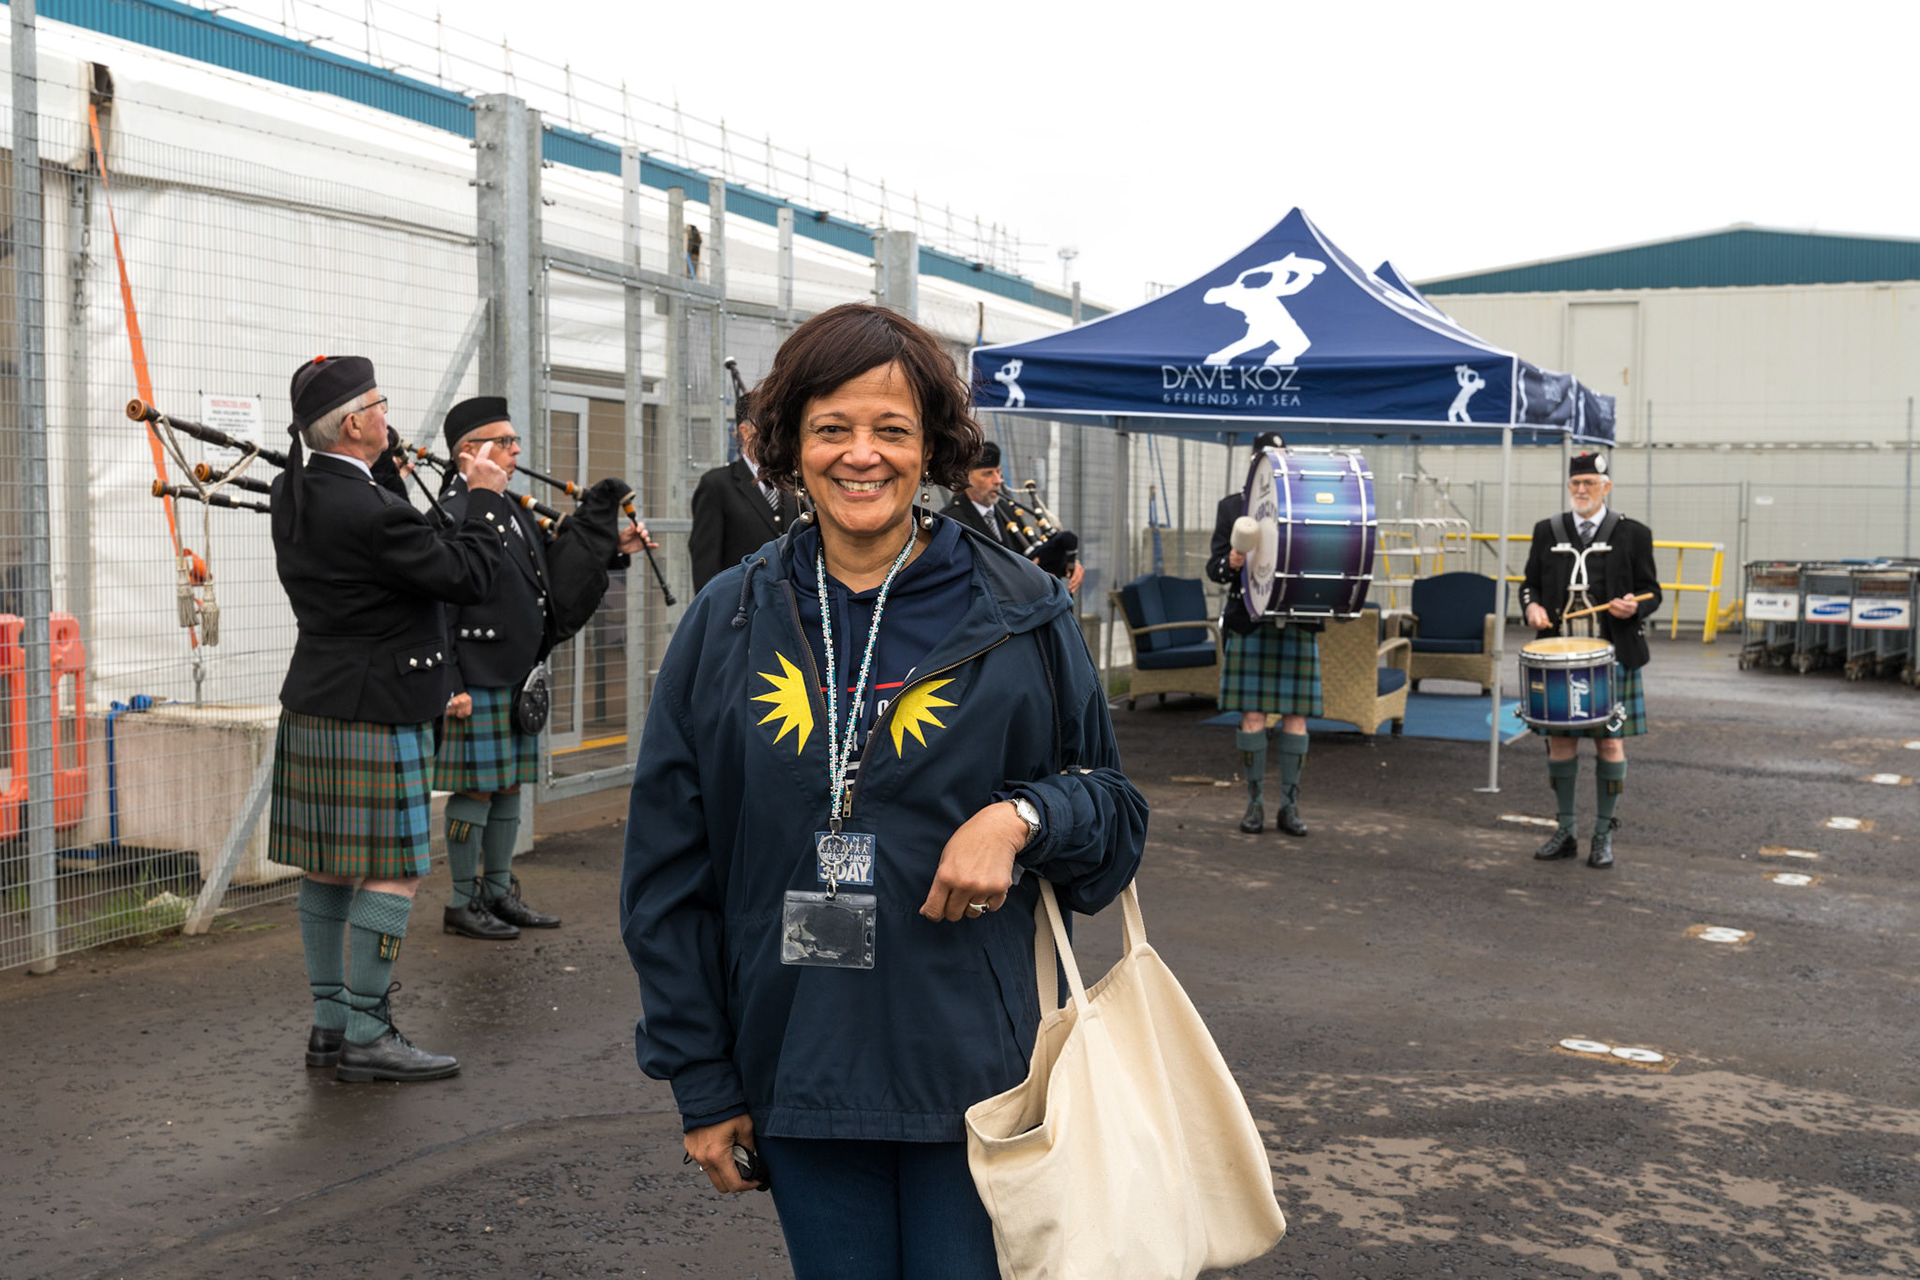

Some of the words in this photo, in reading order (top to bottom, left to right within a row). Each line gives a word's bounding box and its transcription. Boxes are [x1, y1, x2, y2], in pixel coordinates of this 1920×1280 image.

[1161, 365, 1236, 389] DAVE
[1240, 365, 1301, 390] KOZ
[1173, 392, 1238, 405] FRIENDS
[1246, 393, 1264, 406] AT
[1272, 394, 1301, 407] SEA
[820, 834, 872, 844] AON'S
